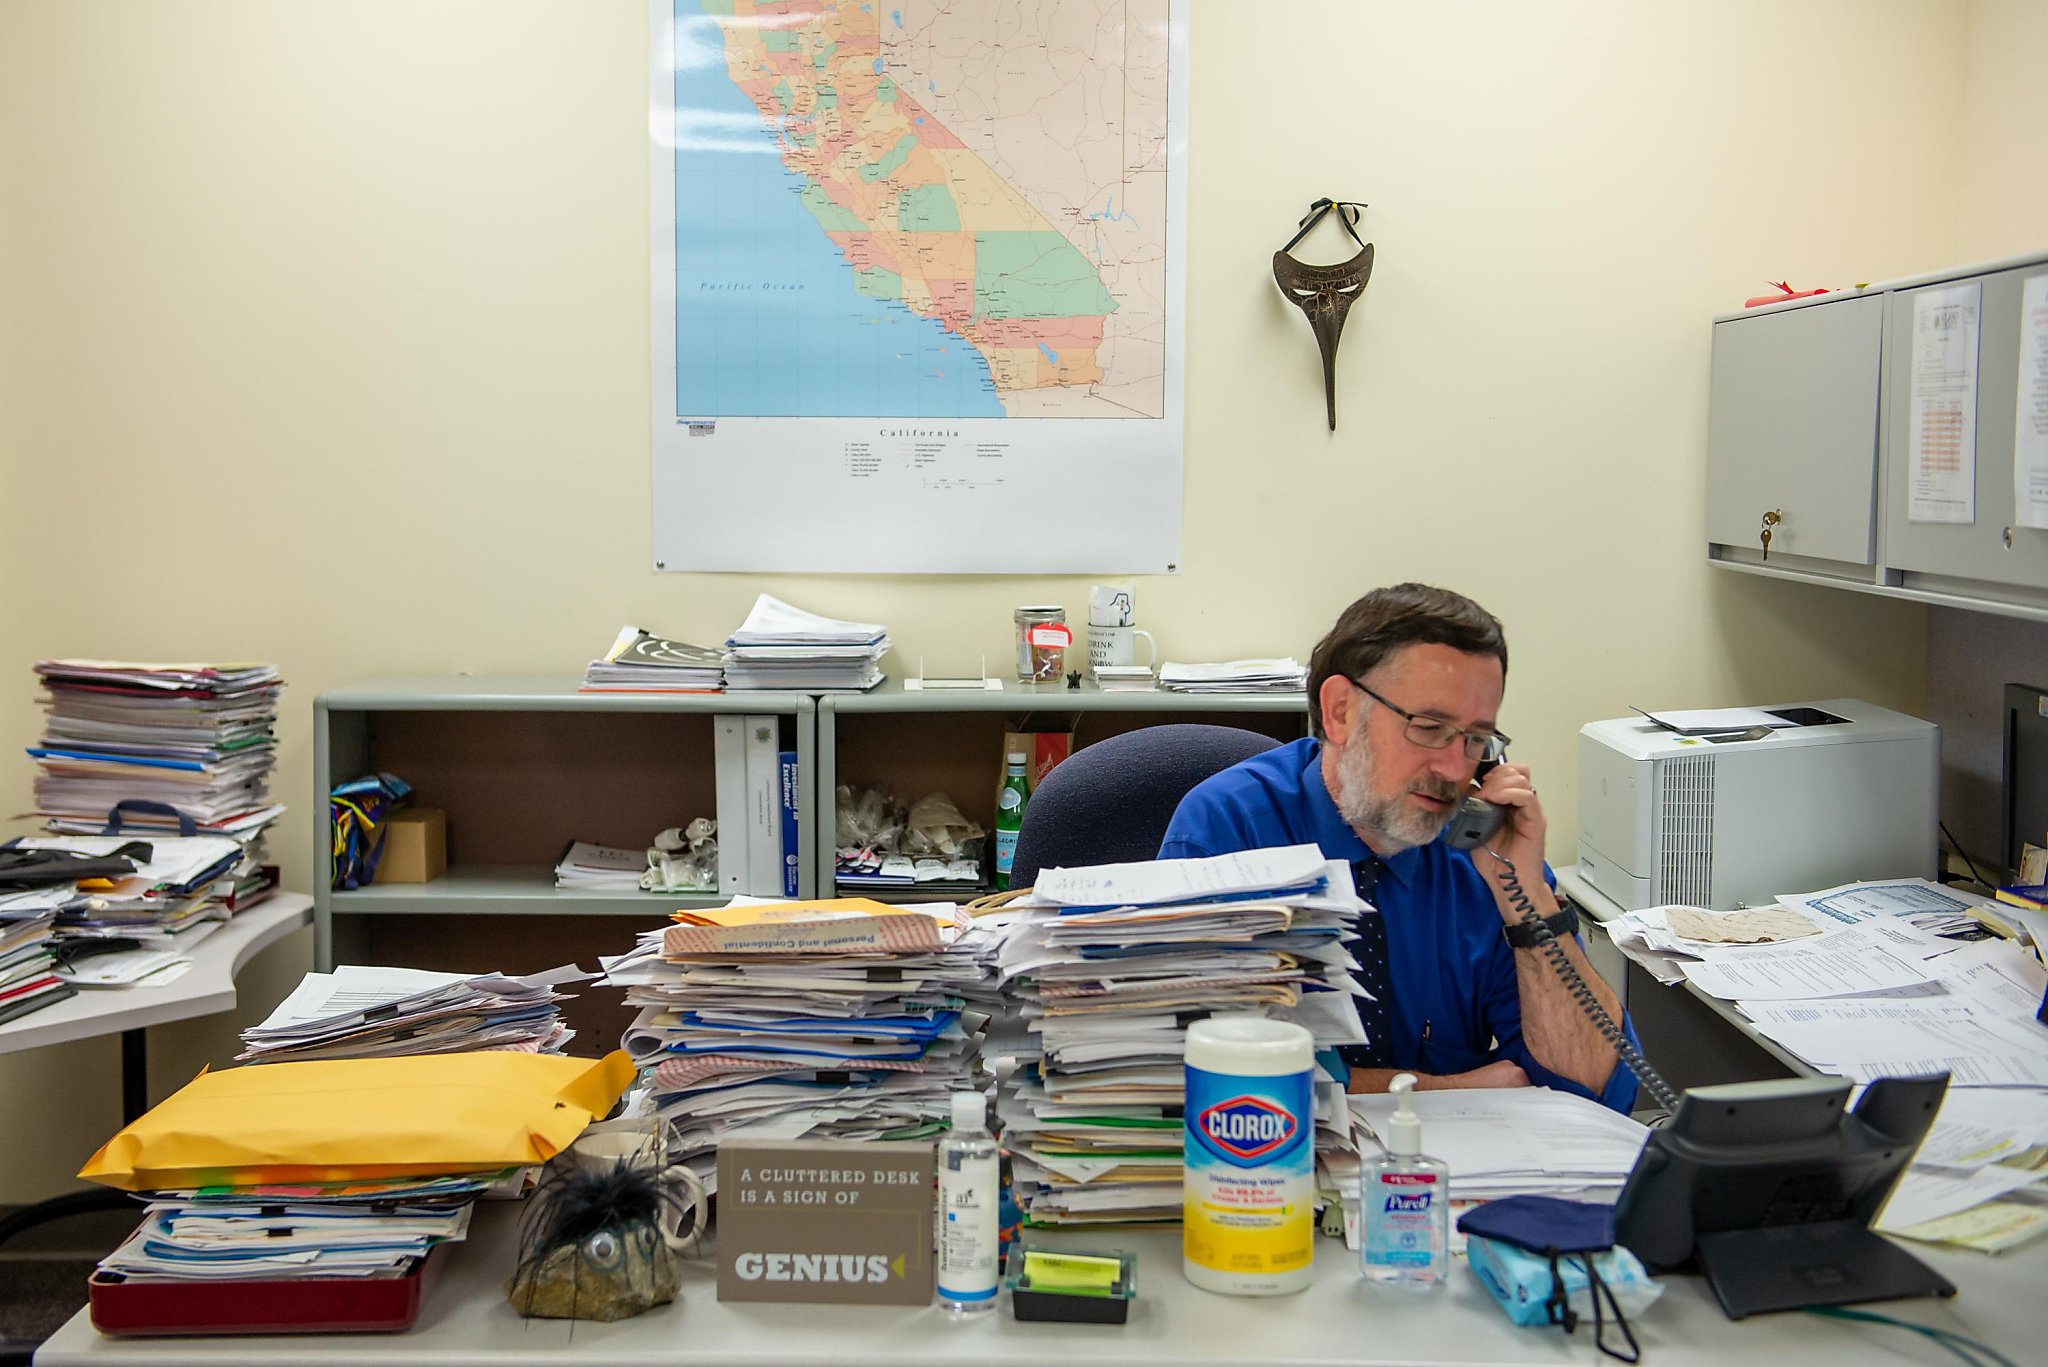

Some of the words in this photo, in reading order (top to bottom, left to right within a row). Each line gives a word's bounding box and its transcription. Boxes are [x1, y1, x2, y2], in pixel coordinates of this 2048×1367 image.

[700, 282, 752, 292] Pacific
[762, 282, 804, 290] Ocean
[879, 429, 959, 437] California
[1090, 650, 1107, 658] AND
[724, 940, 795, 950] Confidential
[798, 939, 820, 948] and
[823, 935, 875, 947] Personal
[1208, 1110, 1286, 1141] CLOROX
[741, 1169, 752, 1182] A
[760, 1169, 866, 1183] CLUTTERED
[873, 1171, 920, 1185] DESK
[741, 1190, 757, 1203] IS
[764, 1190, 776, 1203] A
[783, 1190, 827, 1204] SIGN
[835, 1191, 860, 1205] OF
[735, 1252, 889, 1283] GENIUS
